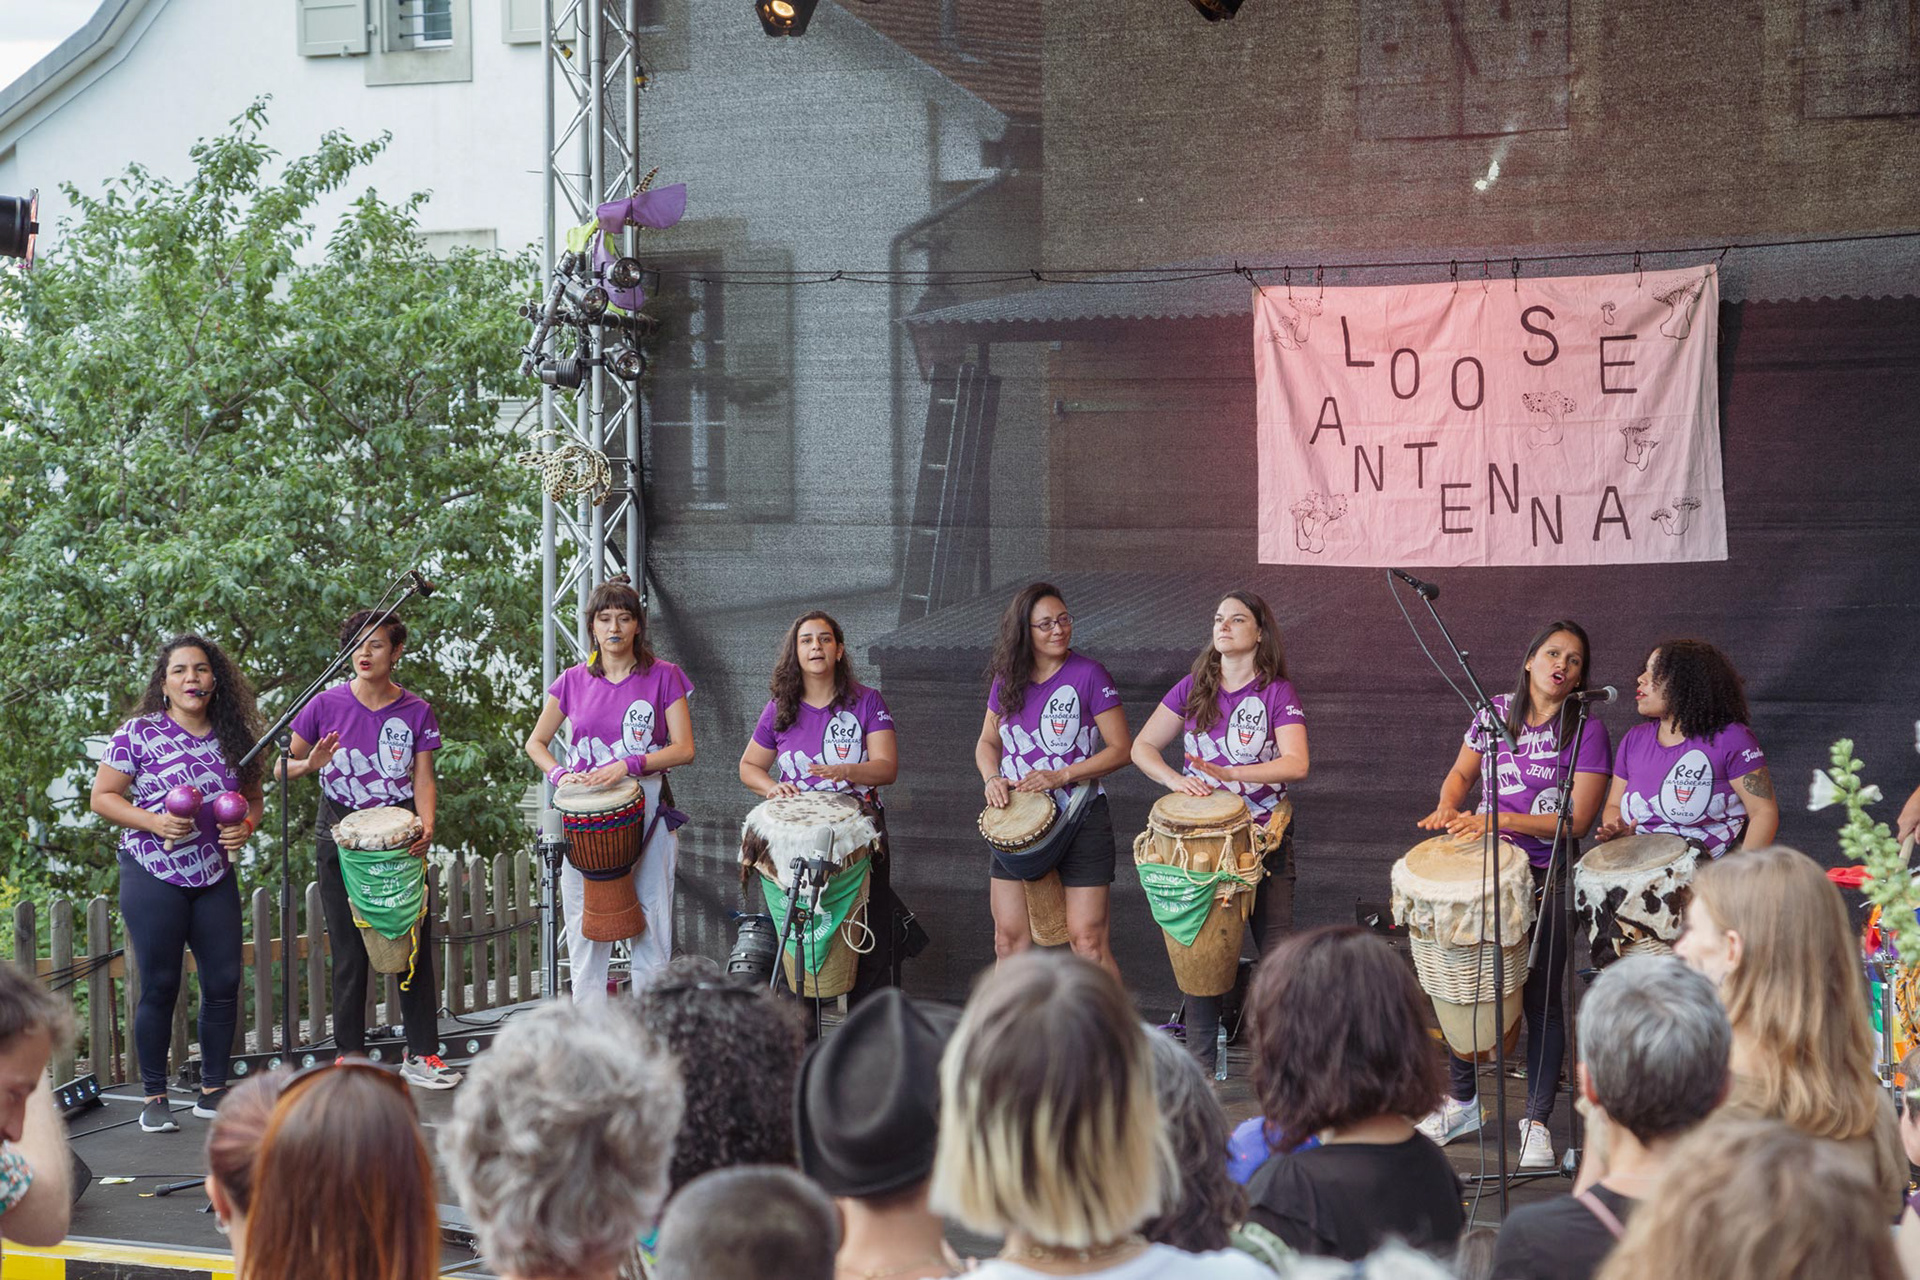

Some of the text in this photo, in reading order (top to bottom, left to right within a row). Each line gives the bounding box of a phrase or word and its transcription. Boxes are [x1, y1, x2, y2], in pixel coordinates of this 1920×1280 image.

[1341, 305, 1638, 411] LOOSE
[1309, 396, 1632, 547] ANTENNA
[1050, 697, 1076, 714] Red
[629, 709, 652, 724] Red
[1238, 708, 1264, 726] Red
[385, 727, 409, 743] Red
[830, 723, 857, 739] Red
[1235, 749, 1253, 758] Suiza
[1526, 763, 1556, 780] JENN
[1675, 764, 1707, 780] Red
[1671, 808, 1694, 817] Suiza
